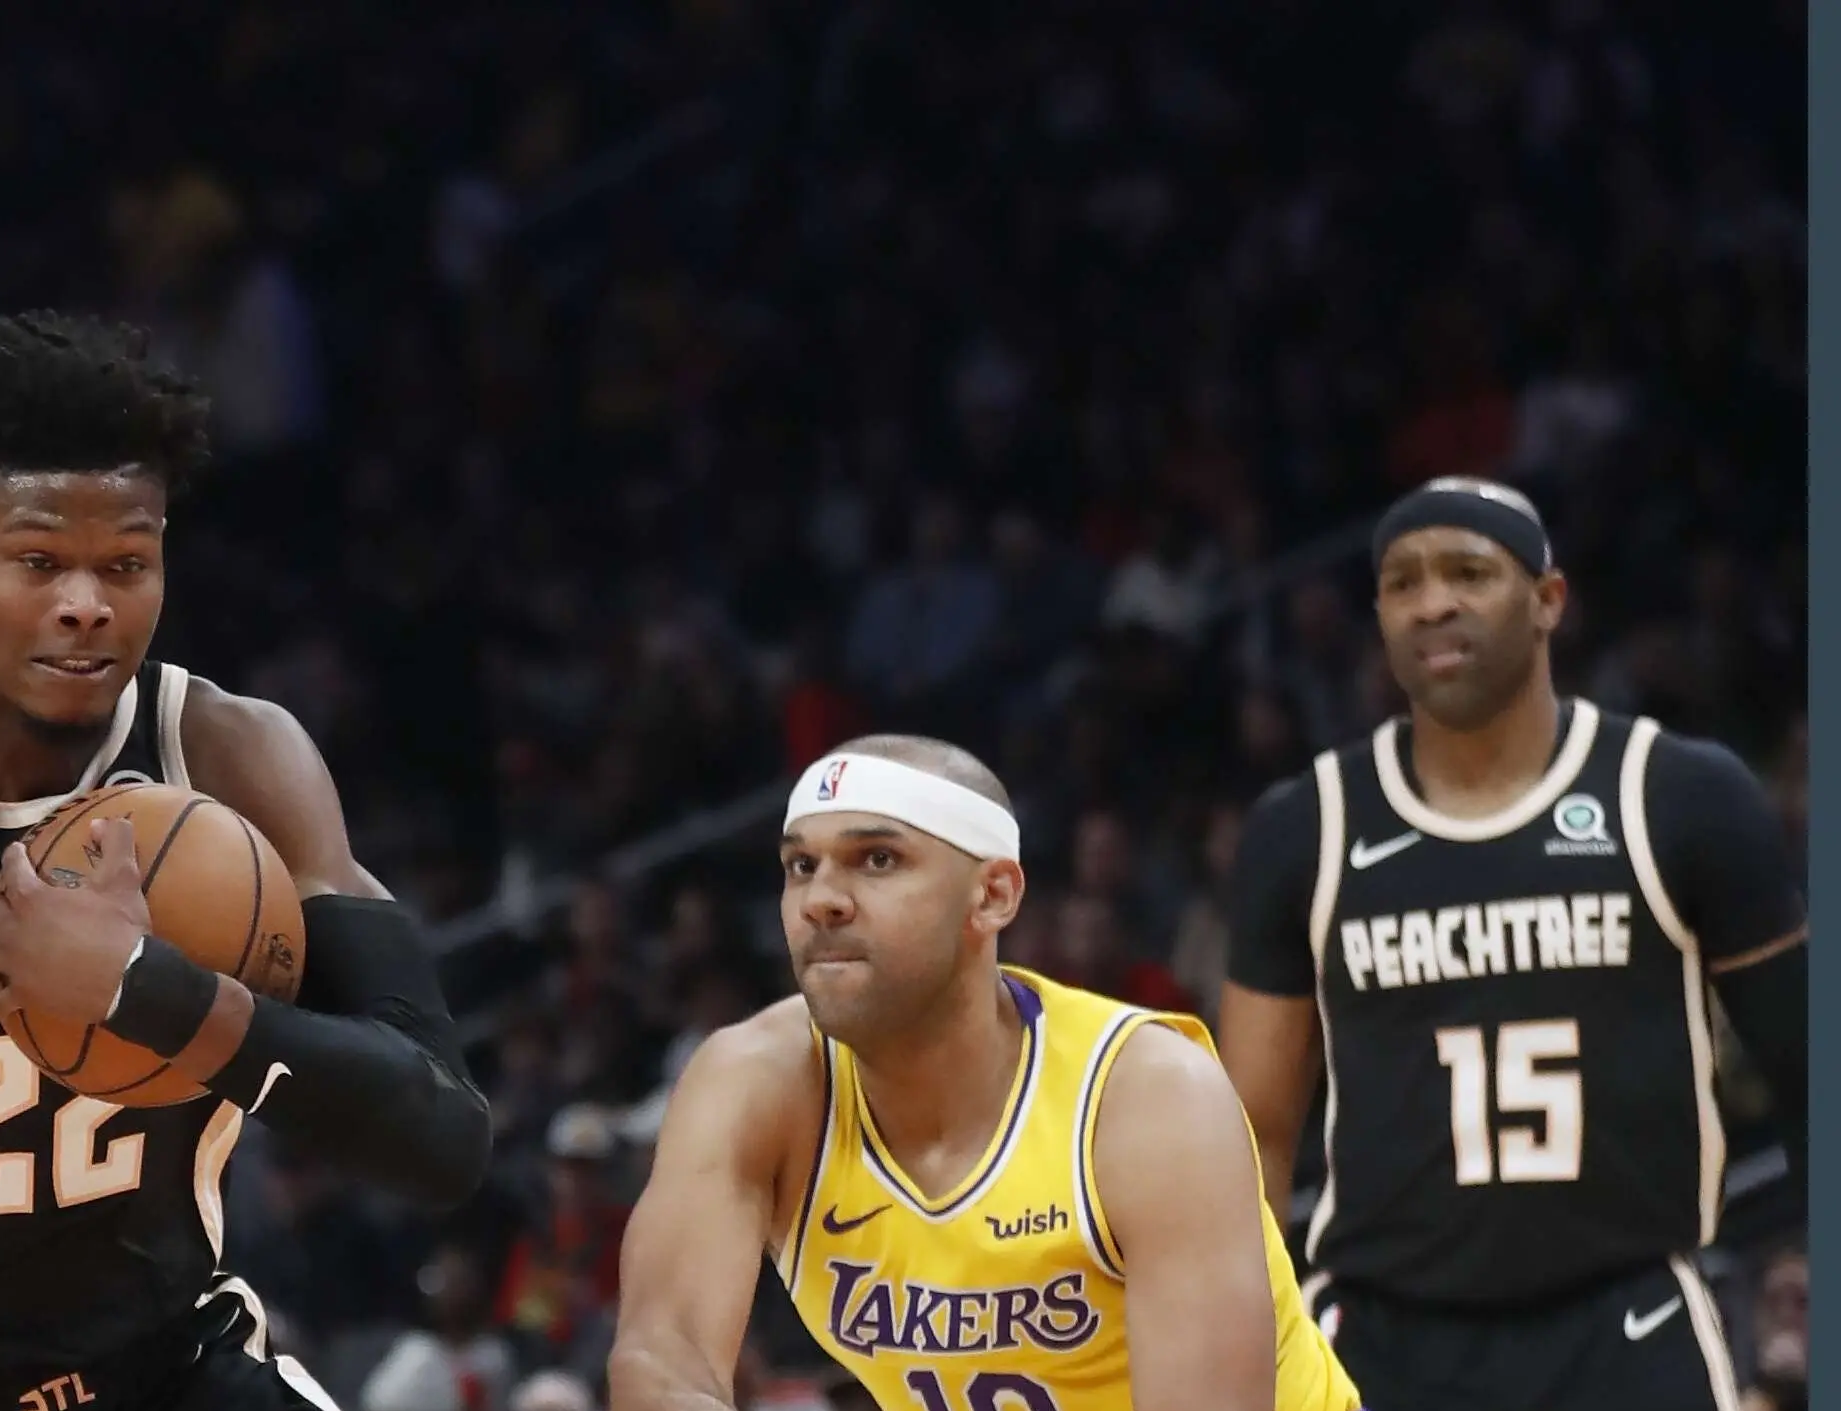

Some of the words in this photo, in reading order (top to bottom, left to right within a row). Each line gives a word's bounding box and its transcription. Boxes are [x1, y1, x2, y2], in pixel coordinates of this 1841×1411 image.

[1340, 893, 1632, 991] PEACHTREE
[1434, 1018, 1583, 1186] 15
[985, 1205, 1068, 1240] wish
[827, 1260, 1101, 1358] LAKERS
